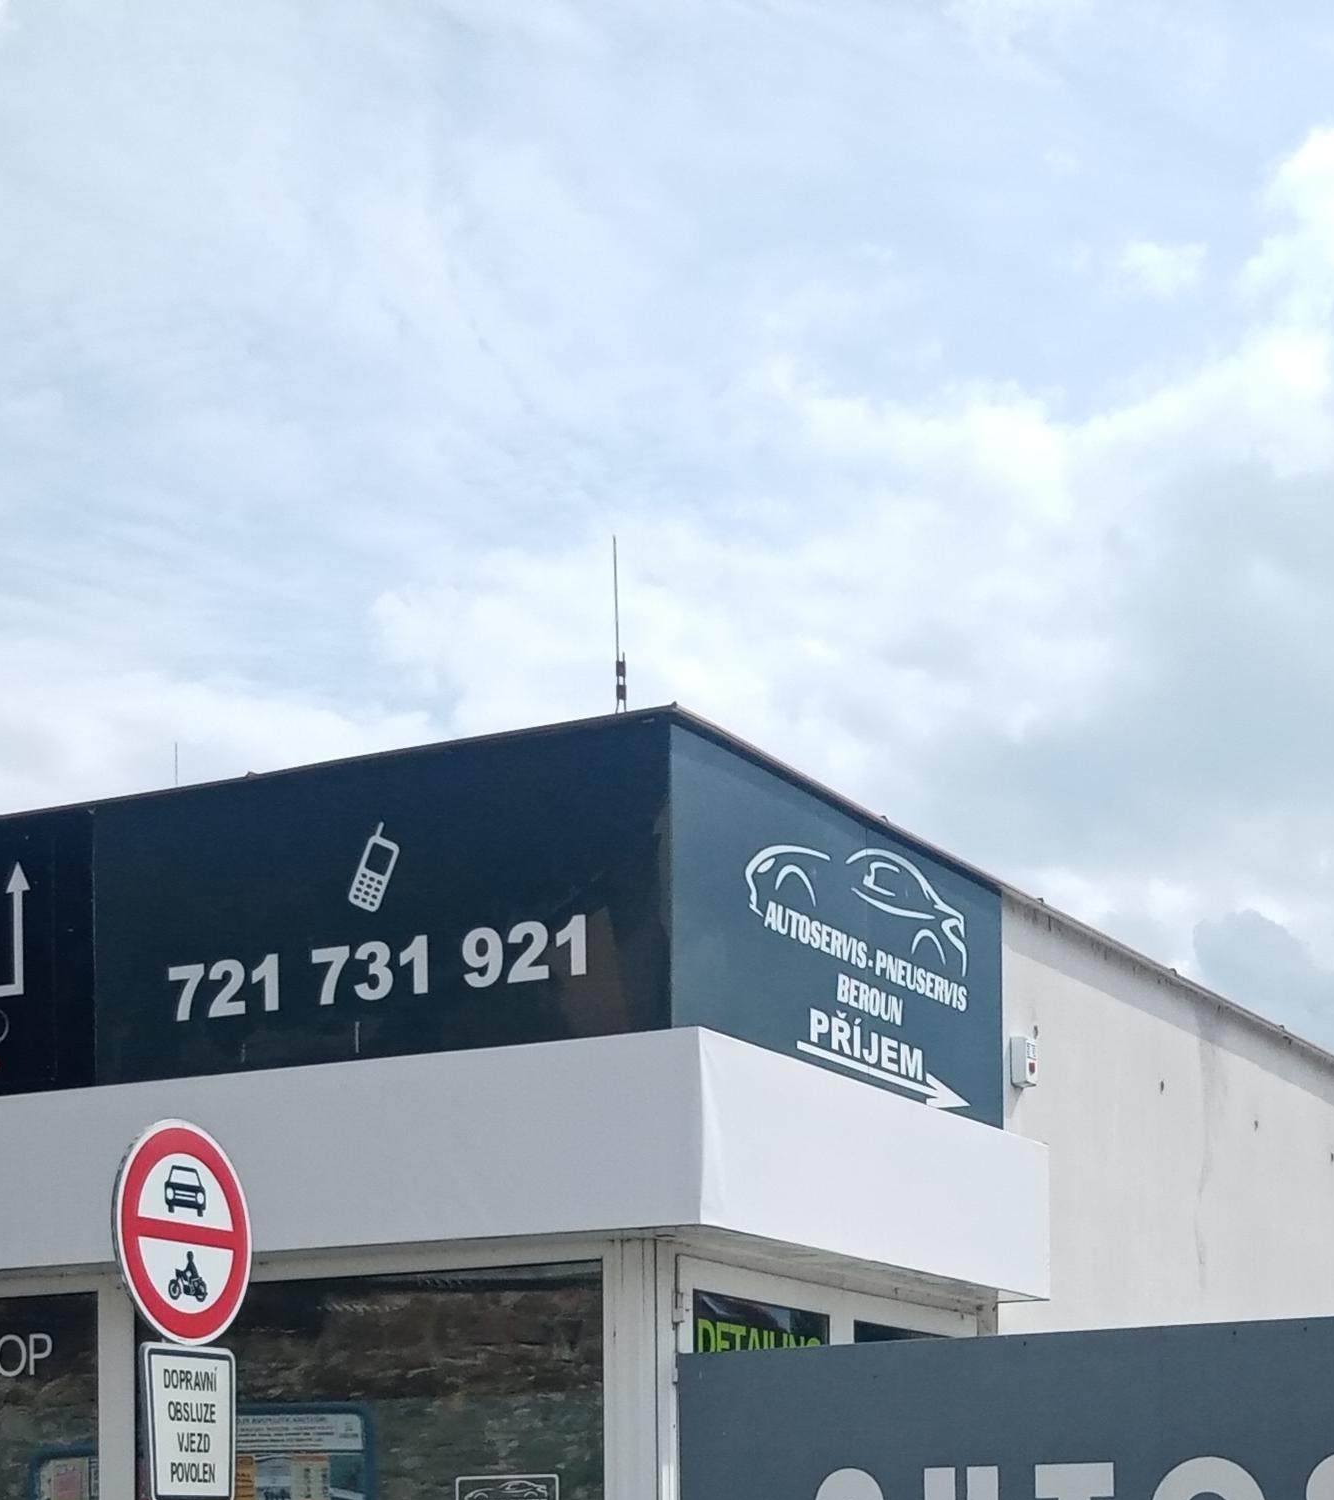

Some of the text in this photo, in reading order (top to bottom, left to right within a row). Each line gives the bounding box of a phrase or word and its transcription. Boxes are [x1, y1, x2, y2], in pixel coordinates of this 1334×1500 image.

[168, 913, 587, 1022] 721 731 921
[764, 900, 868, 969] AUTOSERVIS
[875, 949, 968, 1012] PNEUSERVIS
[836, 973, 903, 1026] BEROUN
[809, 1007, 924, 1082] PŘÍJEM
[163, 1366, 218, 1392] DOPRAVNÍ
[168, 1401, 216, 1423] OBSLUZE
[177, 1432, 210, 1453] VJEZD
[171, 1462, 215, 1483] POVOLEN
